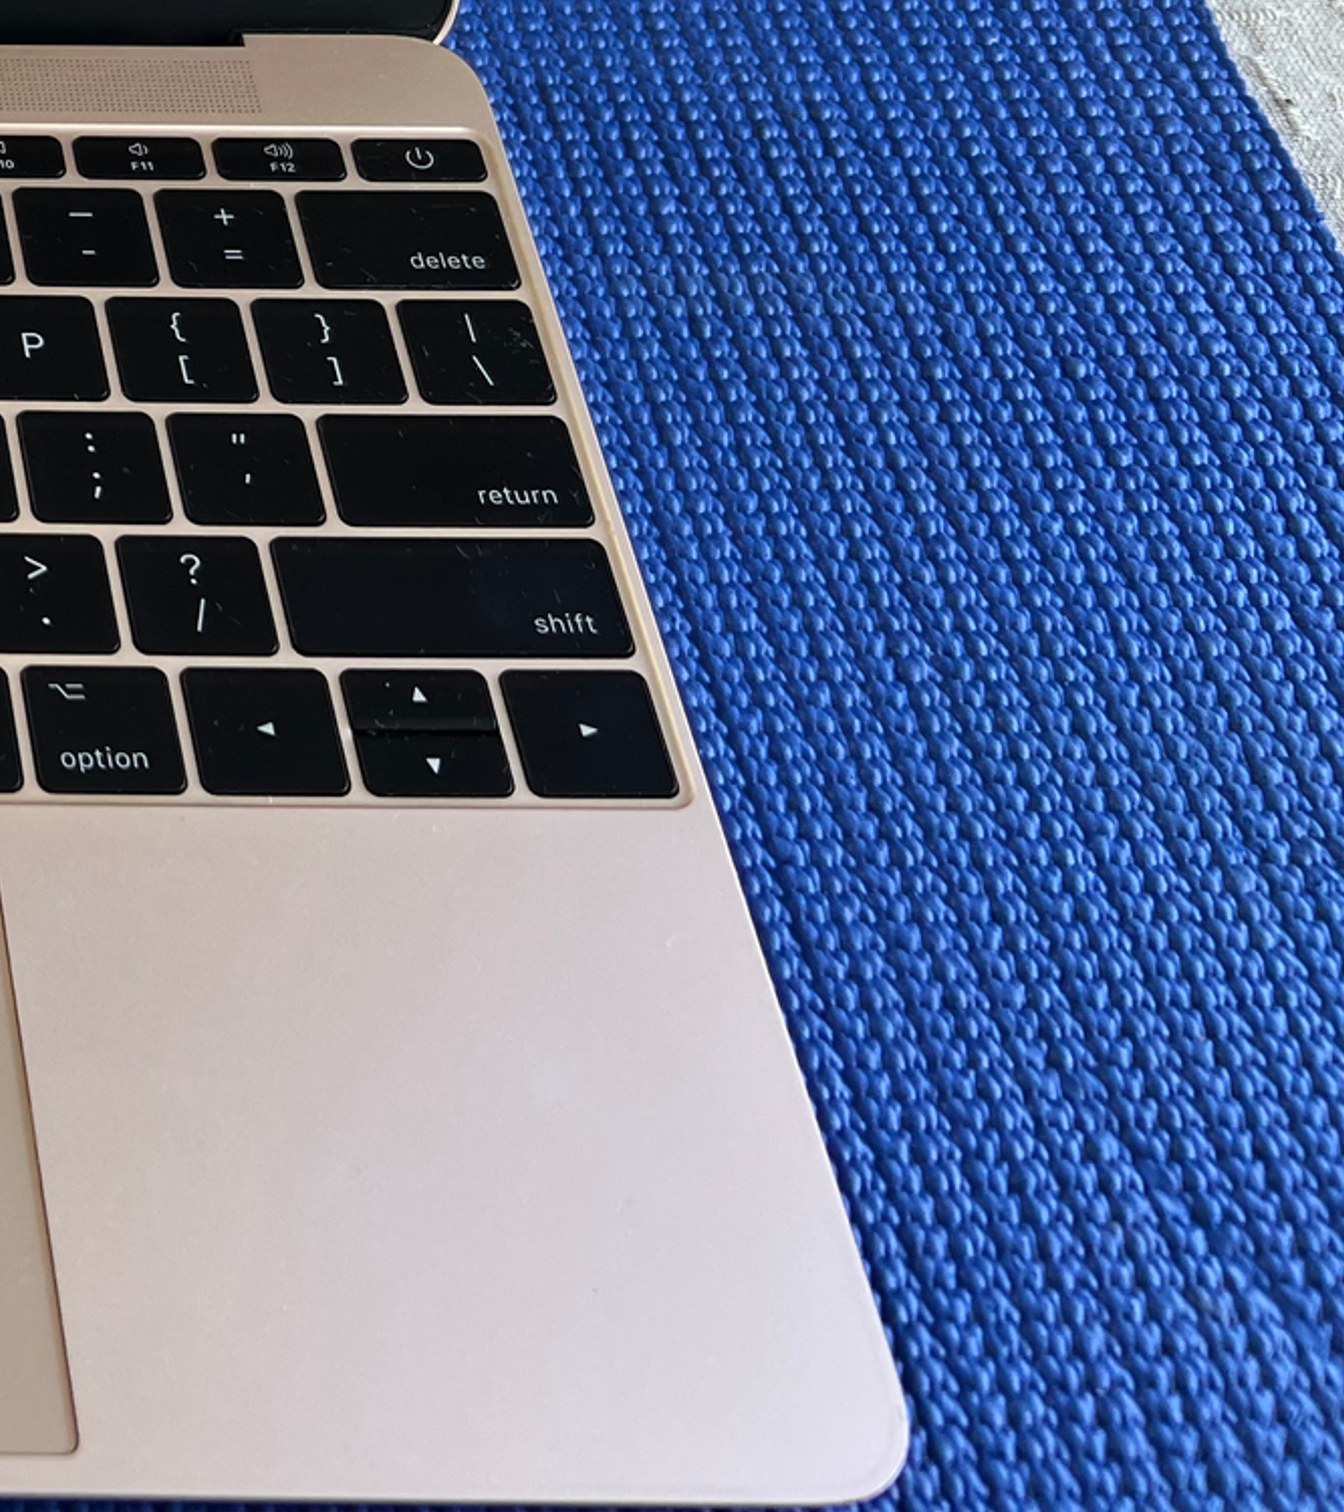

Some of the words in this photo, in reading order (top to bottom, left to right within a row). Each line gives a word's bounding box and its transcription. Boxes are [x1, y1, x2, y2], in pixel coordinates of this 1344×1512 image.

[409, 251, 486, 270] delete
[20, 332, 45, 359] P
[477, 486, 559, 505] return
[533, 612, 598, 634] shift
[60, 745, 150, 774] option
